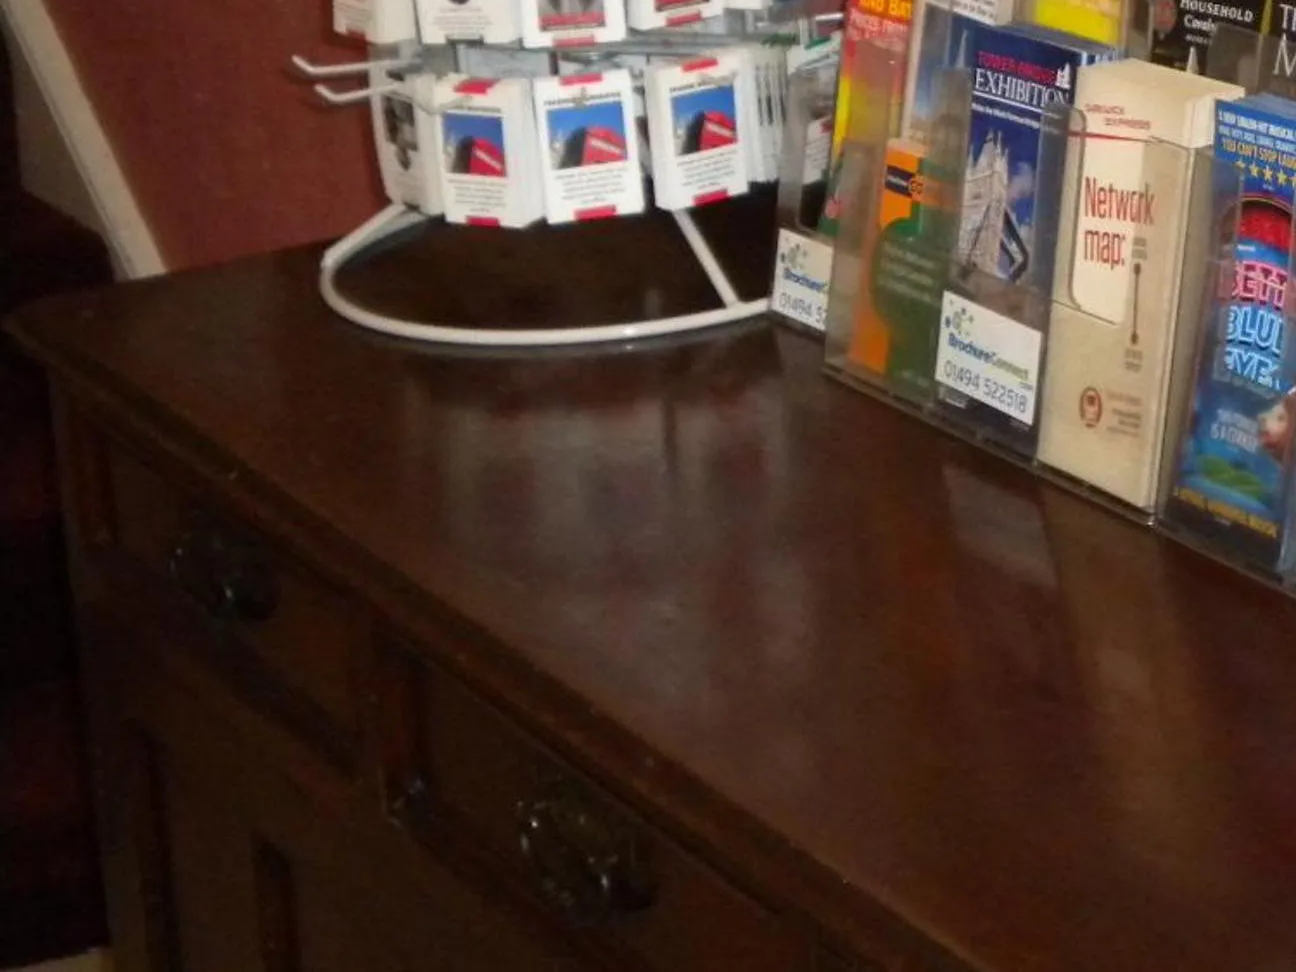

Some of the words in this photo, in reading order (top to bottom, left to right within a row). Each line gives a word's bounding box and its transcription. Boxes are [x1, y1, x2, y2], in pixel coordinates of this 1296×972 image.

[974, 68, 1070, 107] EXHIBITION
[1084, 176, 1155, 227] Network
[942, 359, 981, 394] 01494
[983, 374, 1029, 415] 522518
